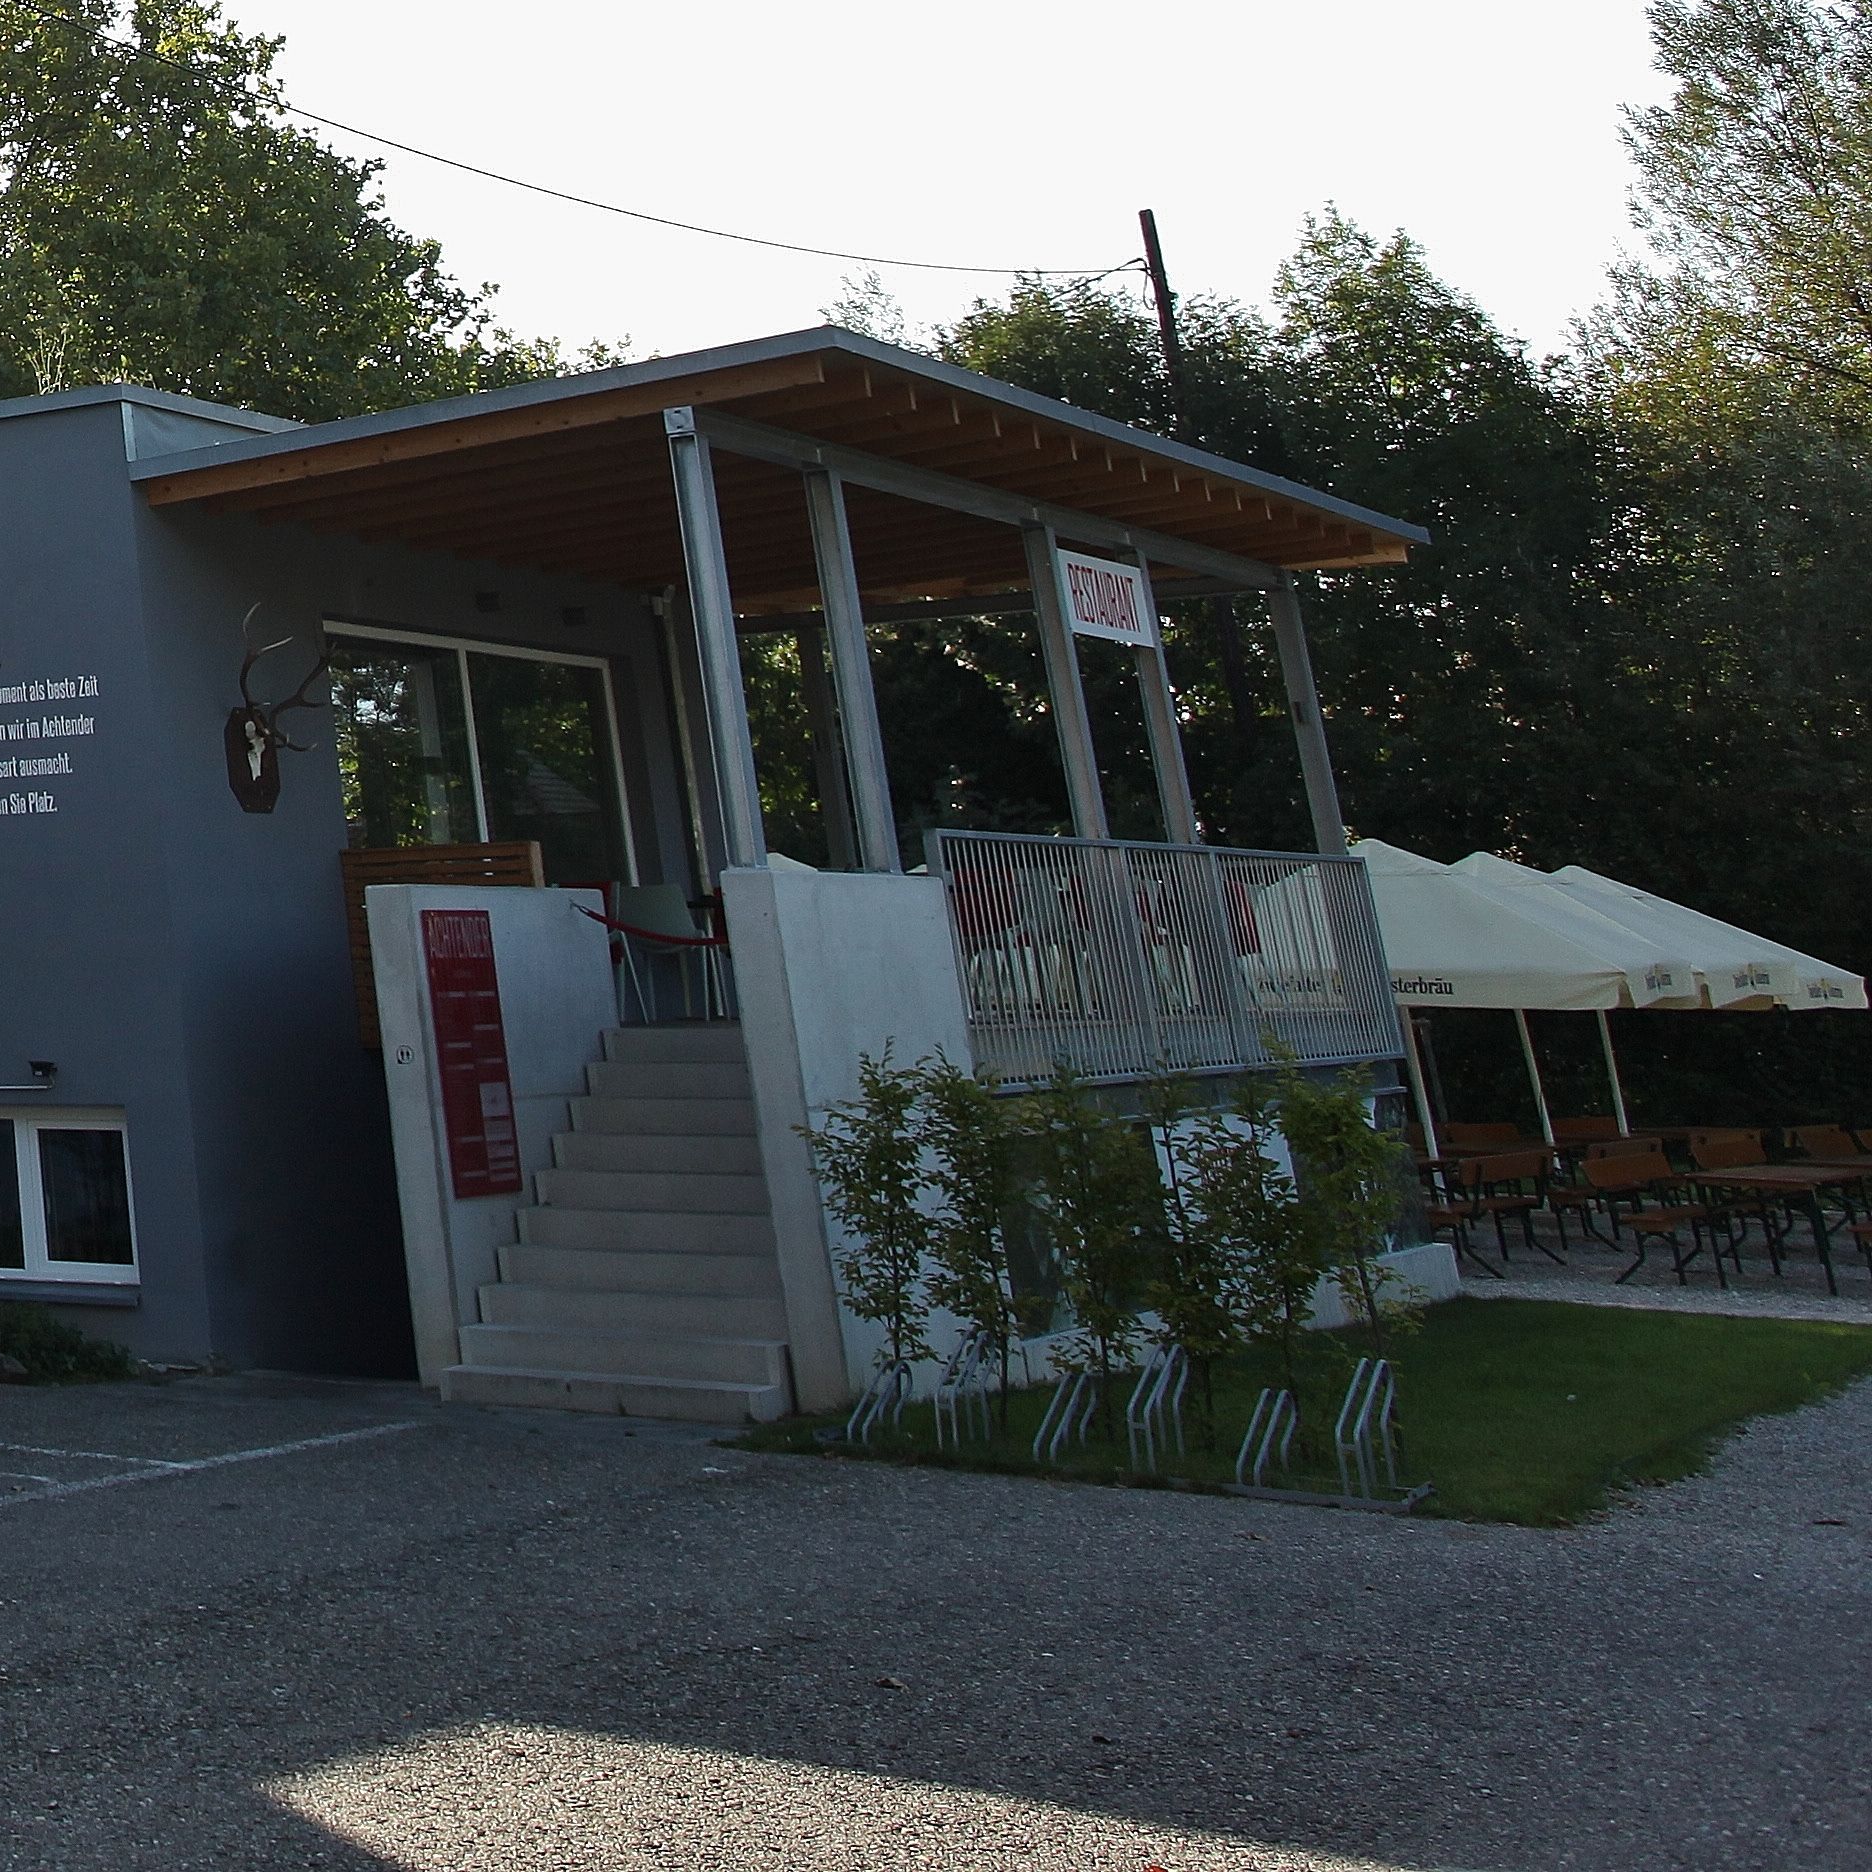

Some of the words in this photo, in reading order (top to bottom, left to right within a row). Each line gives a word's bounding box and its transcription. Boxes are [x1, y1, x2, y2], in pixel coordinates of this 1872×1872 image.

[1067, 562, 1141, 633] RESTAURANT
[28, 679, 46, 702] als
[46, 676, 77, 701] beste
[77, 674, 100, 698] Zeit
[6, 718, 25, 741] wir
[25, 717, 40, 740] im
[40, 712, 96, 738] Achtender
[18, 752, 73, 777] ausmacht.
[9, 792, 27, 815] Sie
[27, 790, 58, 814] Platz.
[428, 916, 491, 959] ACHTENDER
